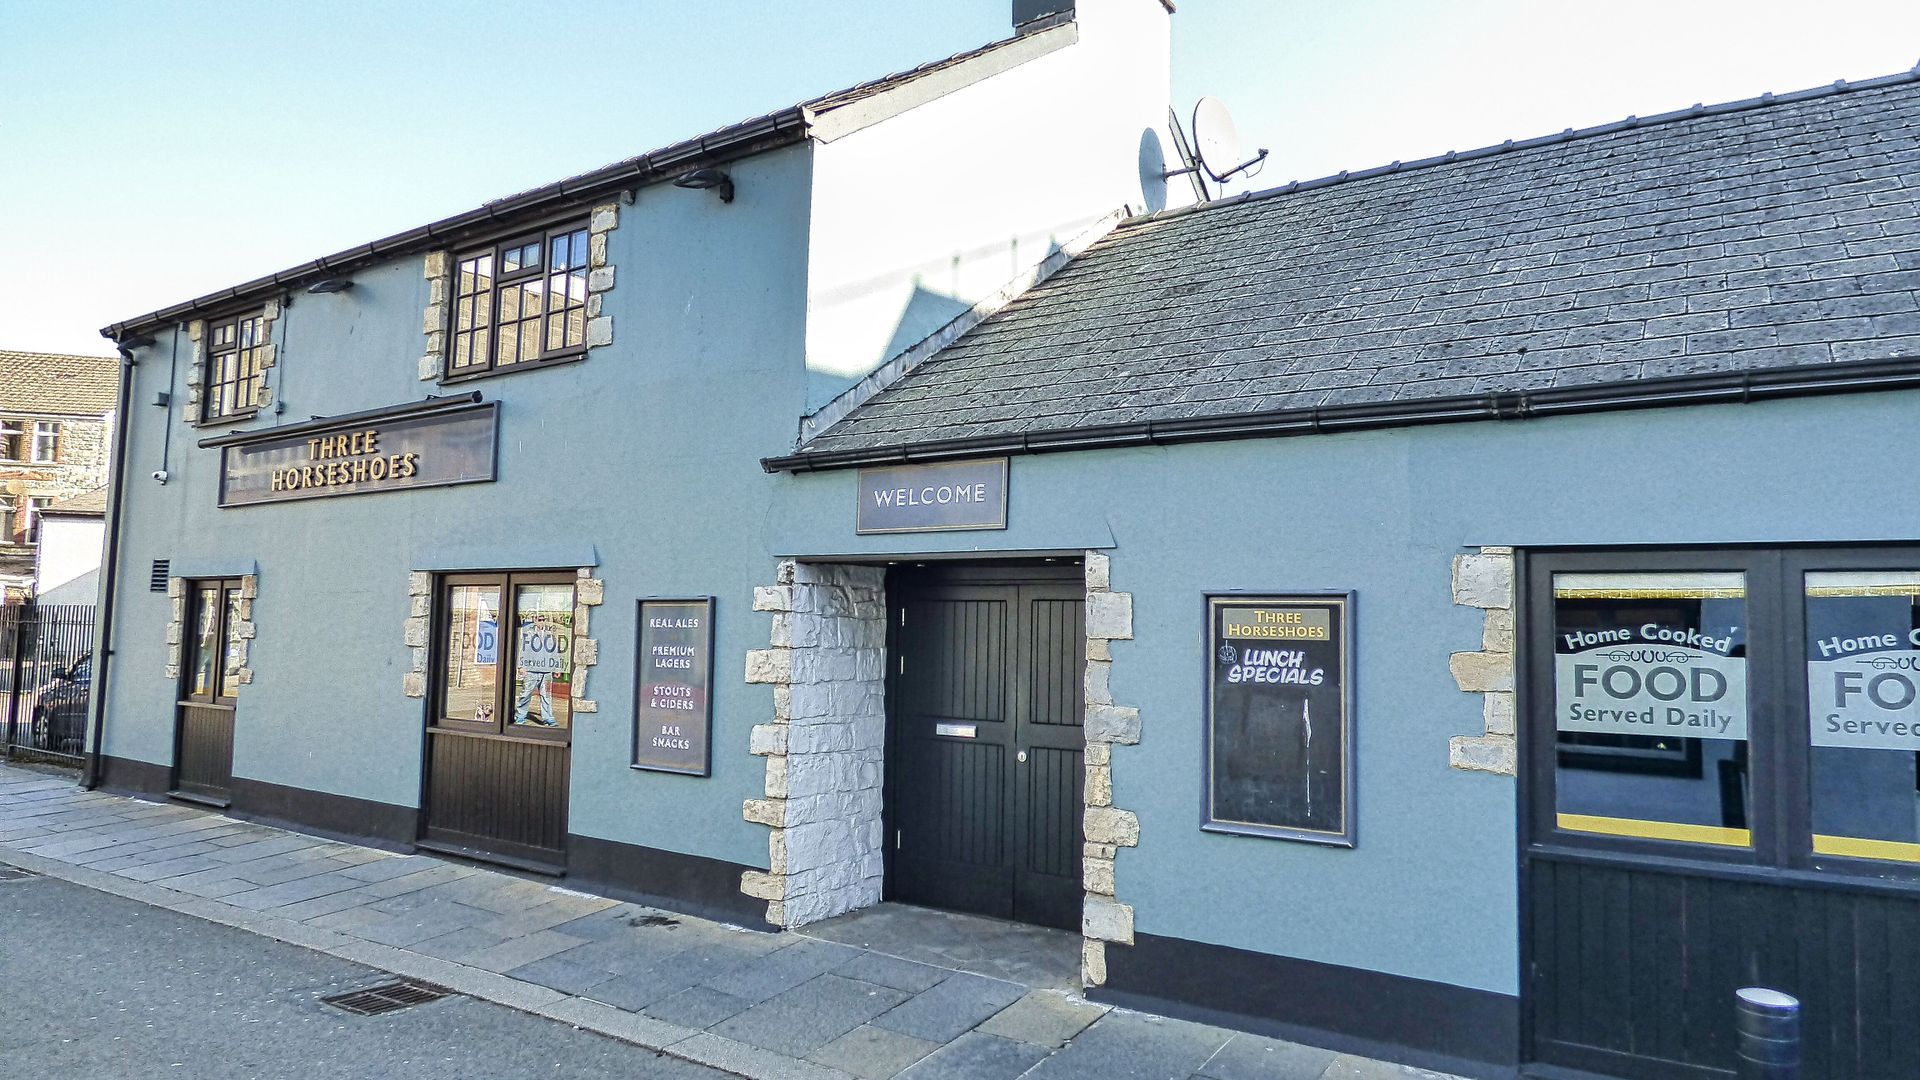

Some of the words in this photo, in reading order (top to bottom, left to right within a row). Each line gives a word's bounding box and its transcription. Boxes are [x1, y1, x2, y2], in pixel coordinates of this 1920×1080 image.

[307, 430, 378, 460] THREE
[271, 452, 416, 491] HORSESHOES
[874, 483, 986, 508] WELCOME
[650, 618, 673, 628] REAL
[675, 618, 699, 628] ALES
[1254, 610, 1302, 624] THREE
[1227, 624, 1324, 638] HORSESHOES
[1564, 627, 1631, 650] Home
[1640, 623, 1732, 653] Cooked
[522, 632, 569, 653] FOOD
[652, 646, 695, 656] PREMIUM
[1817, 633, 1897, 657] Home
[520, 656, 546, 668] Served
[548, 657, 569, 671] Daily
[655, 659, 691, 668] LAGERS
[1244, 648, 1305, 668] LUNCH
[1227, 665, 1324, 685] SPECIALS
[1574, 664, 1728, 702] FOOD
[653, 686, 692, 697] STOUTS
[650, 698, 657, 708] &
[660, 699, 694, 710] CIDERS
[1569, 703, 1654, 725] Served
[1666, 707, 1732, 733] Daily
[661, 725, 681, 736] BAR
[652, 737, 690, 750] SNACKS
